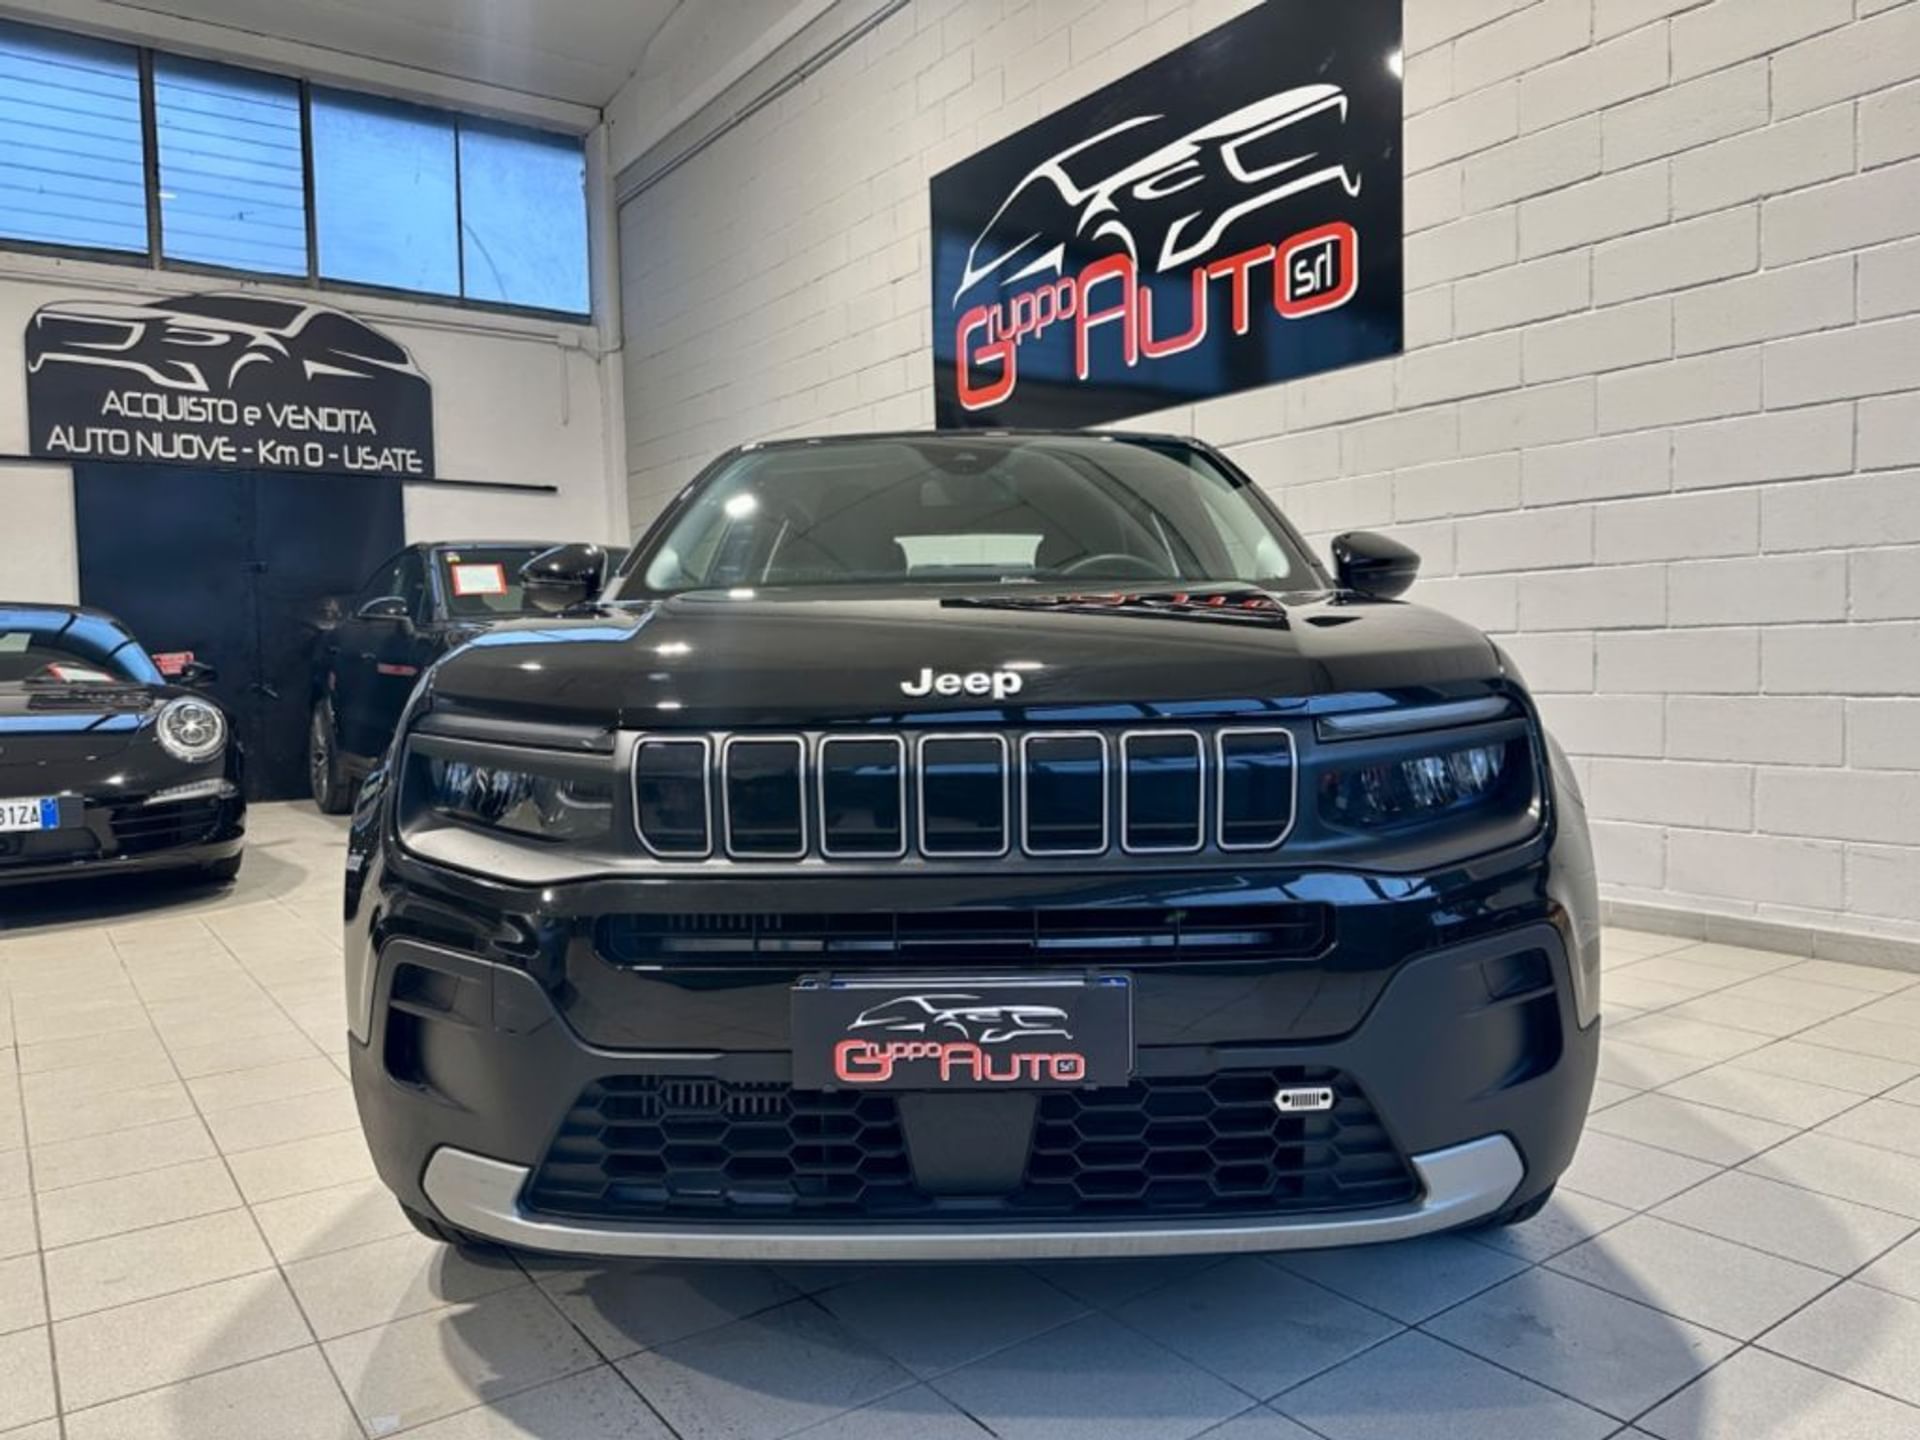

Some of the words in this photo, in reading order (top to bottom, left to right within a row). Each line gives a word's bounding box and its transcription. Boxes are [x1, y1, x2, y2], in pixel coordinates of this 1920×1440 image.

[956, 276, 1077, 412] Gruppo
[102, 390, 238, 424] ACQUISTO
[243, 405, 262, 426] e
[266, 402, 377, 435] VENDITA
[46, 425, 130, 456] AUTO
[136, 430, 237, 462] NUOVE
[258, 438, 299, 466] Km
[343, 445, 423, 473] USATE
[900, 668, 1022, 700] Jeep
[834, 1039, 942, 1081] Gruppo
